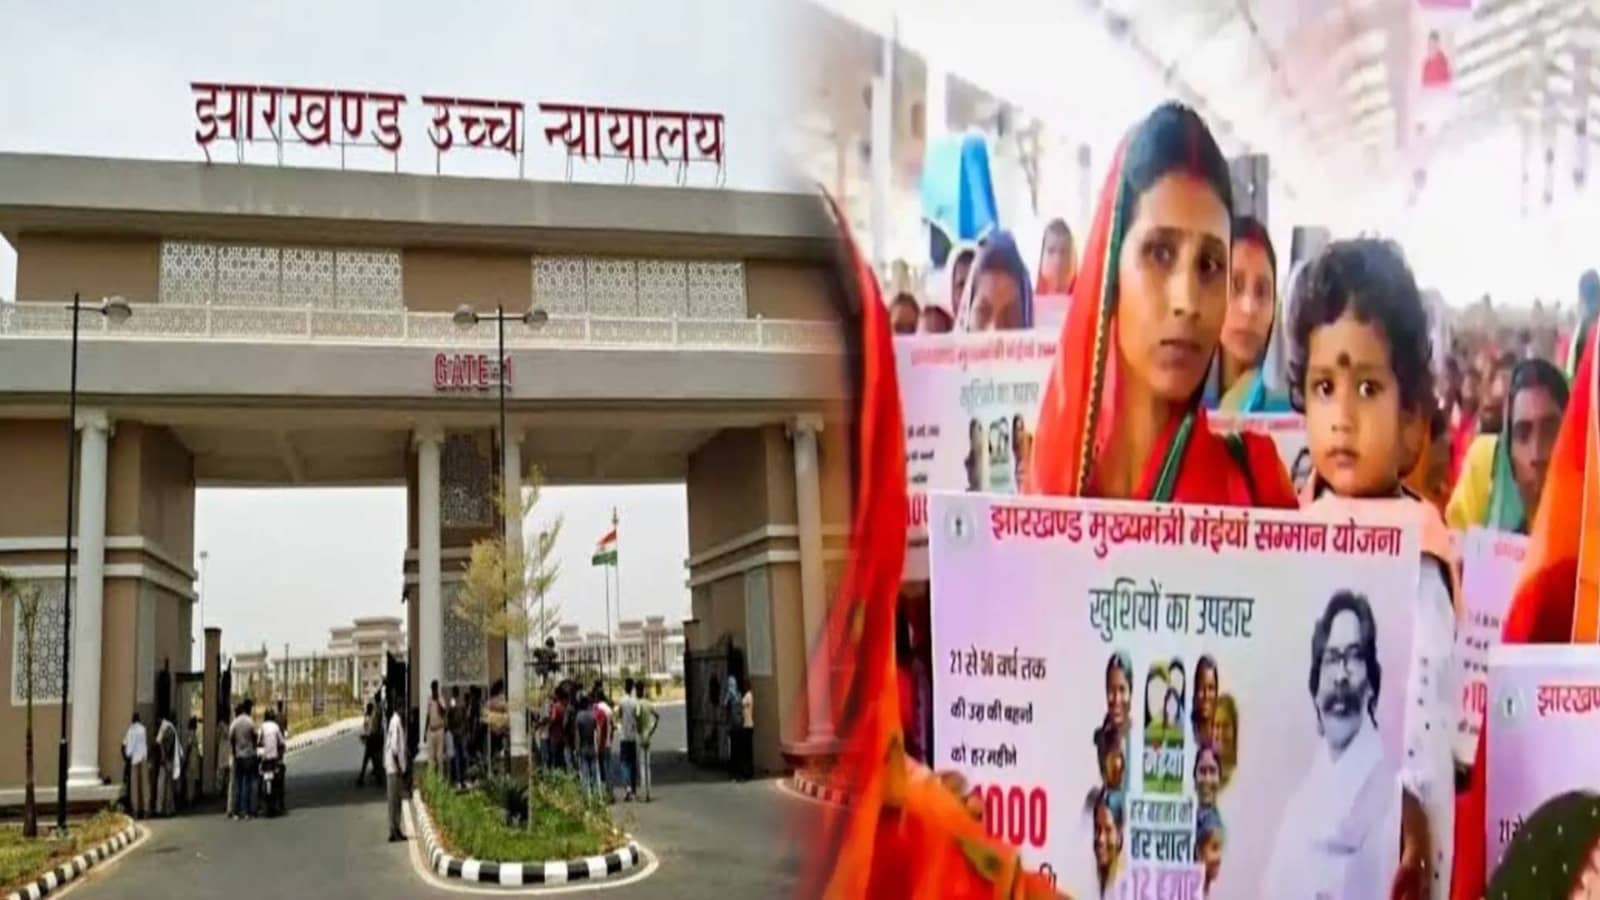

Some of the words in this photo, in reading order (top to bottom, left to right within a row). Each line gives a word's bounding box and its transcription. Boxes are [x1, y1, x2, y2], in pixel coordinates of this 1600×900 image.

[190, 82, 407, 151] झारखण्ड
[421, 95, 525, 156] उच्च
[538, 103, 725, 163] न्यायालय
[989, 505, 1083, 542] झारखण्ड
[1088, 506, 1185, 559] मुख्यमंत्री
[1254, 519, 1329, 553] सम्मान
[1332, 517, 1402, 557] योजना
[1088, 576, 1162, 642] खुशियों
[1165, 592, 1191, 634] का
[1195, 594, 1255, 638] उपहार
[950, 649, 962, 675] 21
[965, 643, 977, 677] से
[1020, 655, 1046, 680] तक
[973, 785, 1047, 848] 000
[1155, 829, 1192, 863] साल
